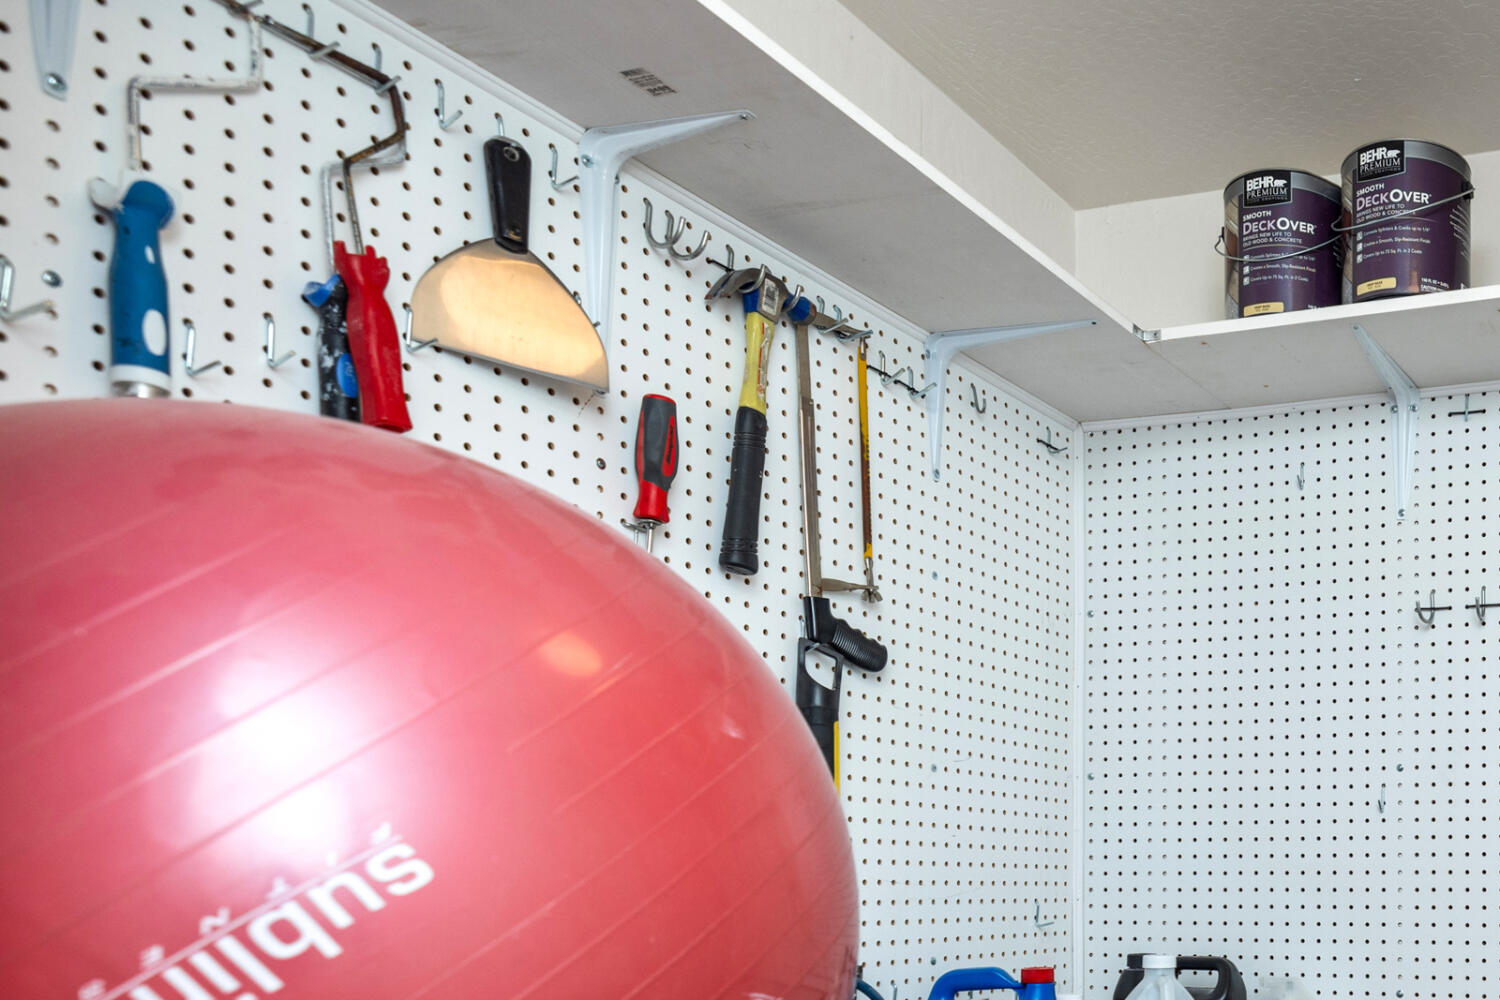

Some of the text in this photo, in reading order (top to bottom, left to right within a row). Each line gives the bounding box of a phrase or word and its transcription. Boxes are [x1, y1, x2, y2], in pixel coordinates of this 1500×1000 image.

[1359, 146, 1387, 166] BEHR
[1359, 158, 1401, 173] PREMIUM
[1246, 175, 1274, 192] BEHR
[1356, 182, 1385, 197] SMOOTH
[1246, 187, 1288, 200] PREMIUM
[1242, 210, 1272, 222] SMOOTH
